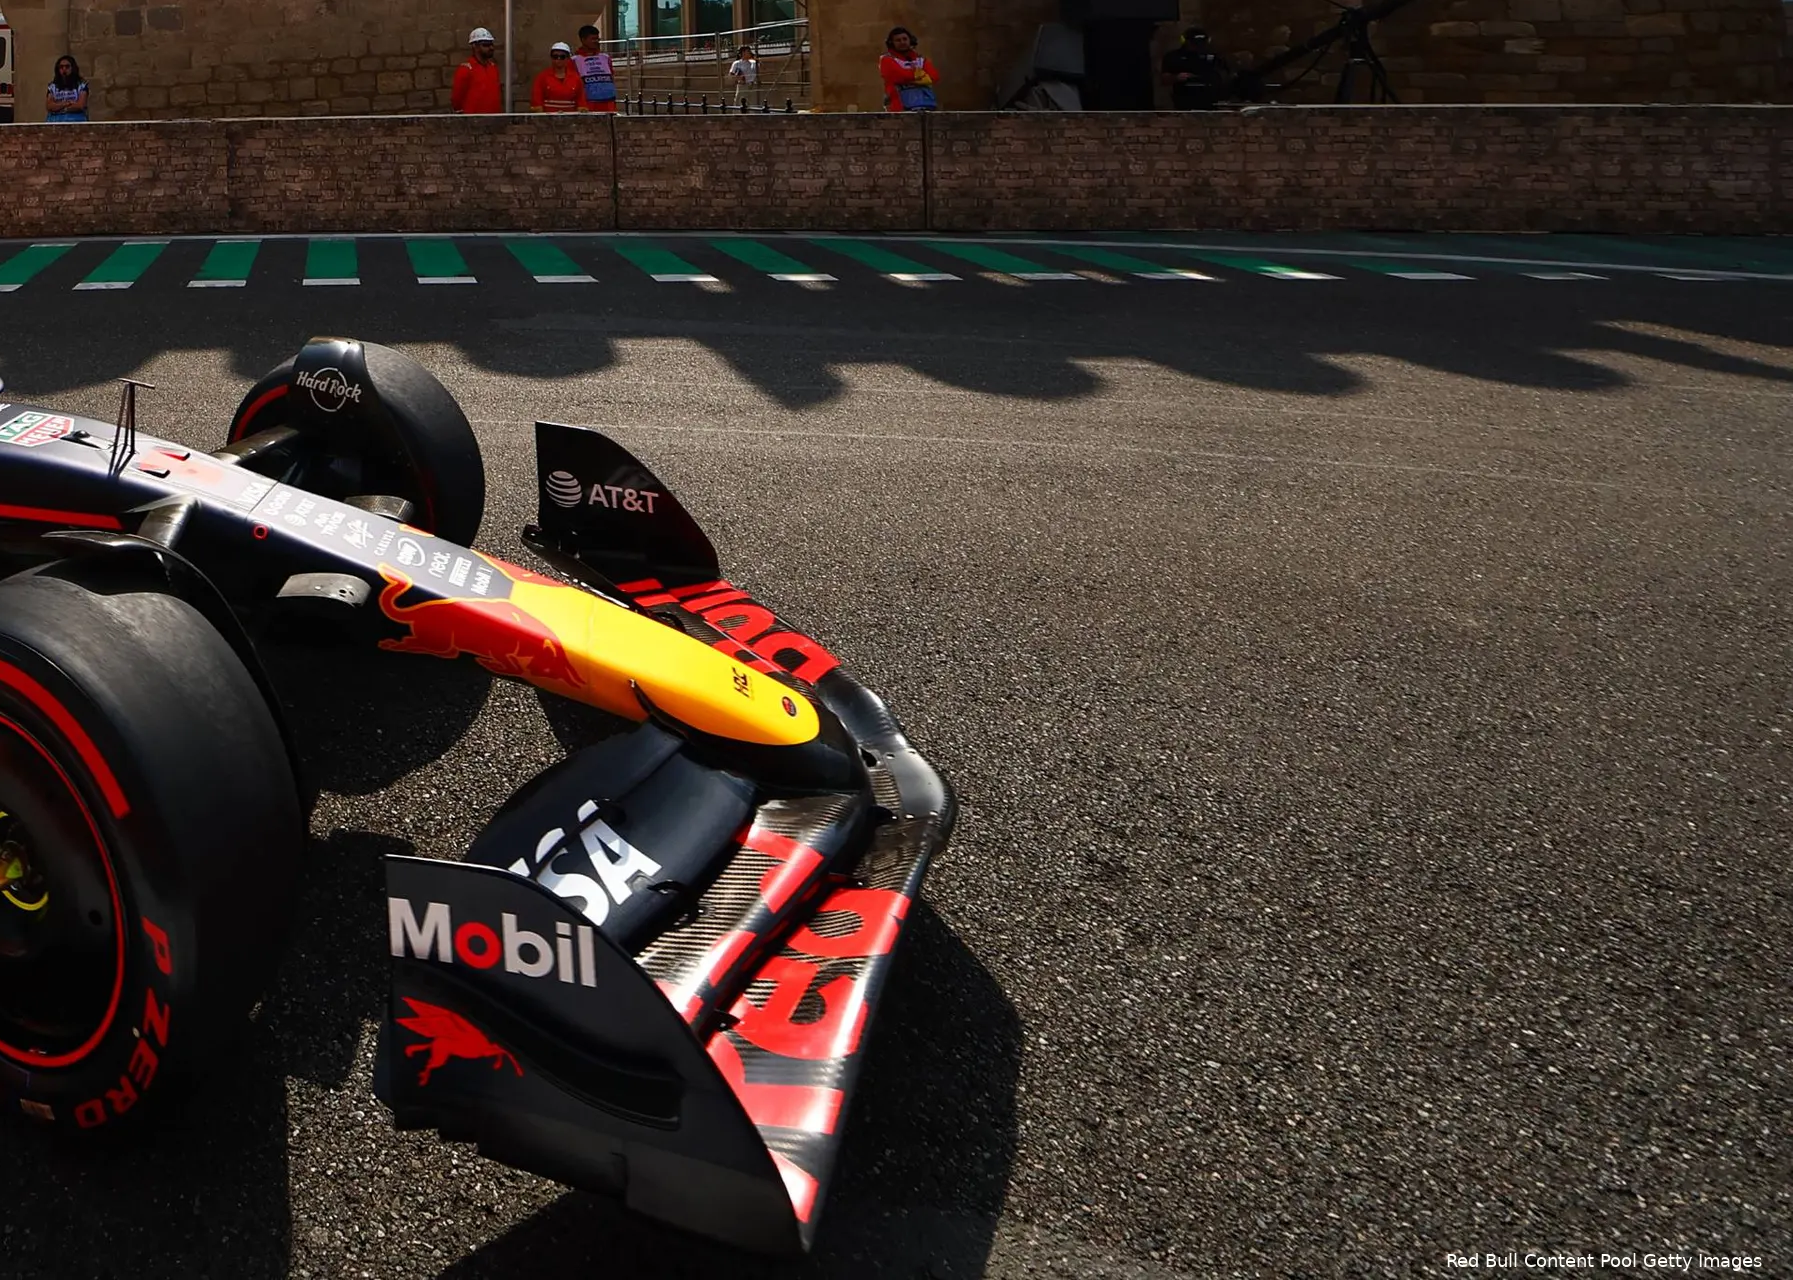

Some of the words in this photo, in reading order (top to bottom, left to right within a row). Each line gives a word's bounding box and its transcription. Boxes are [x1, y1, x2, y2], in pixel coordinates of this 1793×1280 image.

[296, 371, 330, 392] Hard
[329, 379, 362, 403] Rock
[20, 415, 69, 444] HEUER
[588, 483, 660, 514] AT&T
[141, 915, 173, 976] P
[387, 896, 599, 988] Mobil
[74, 986, 171, 1129] ZERO
